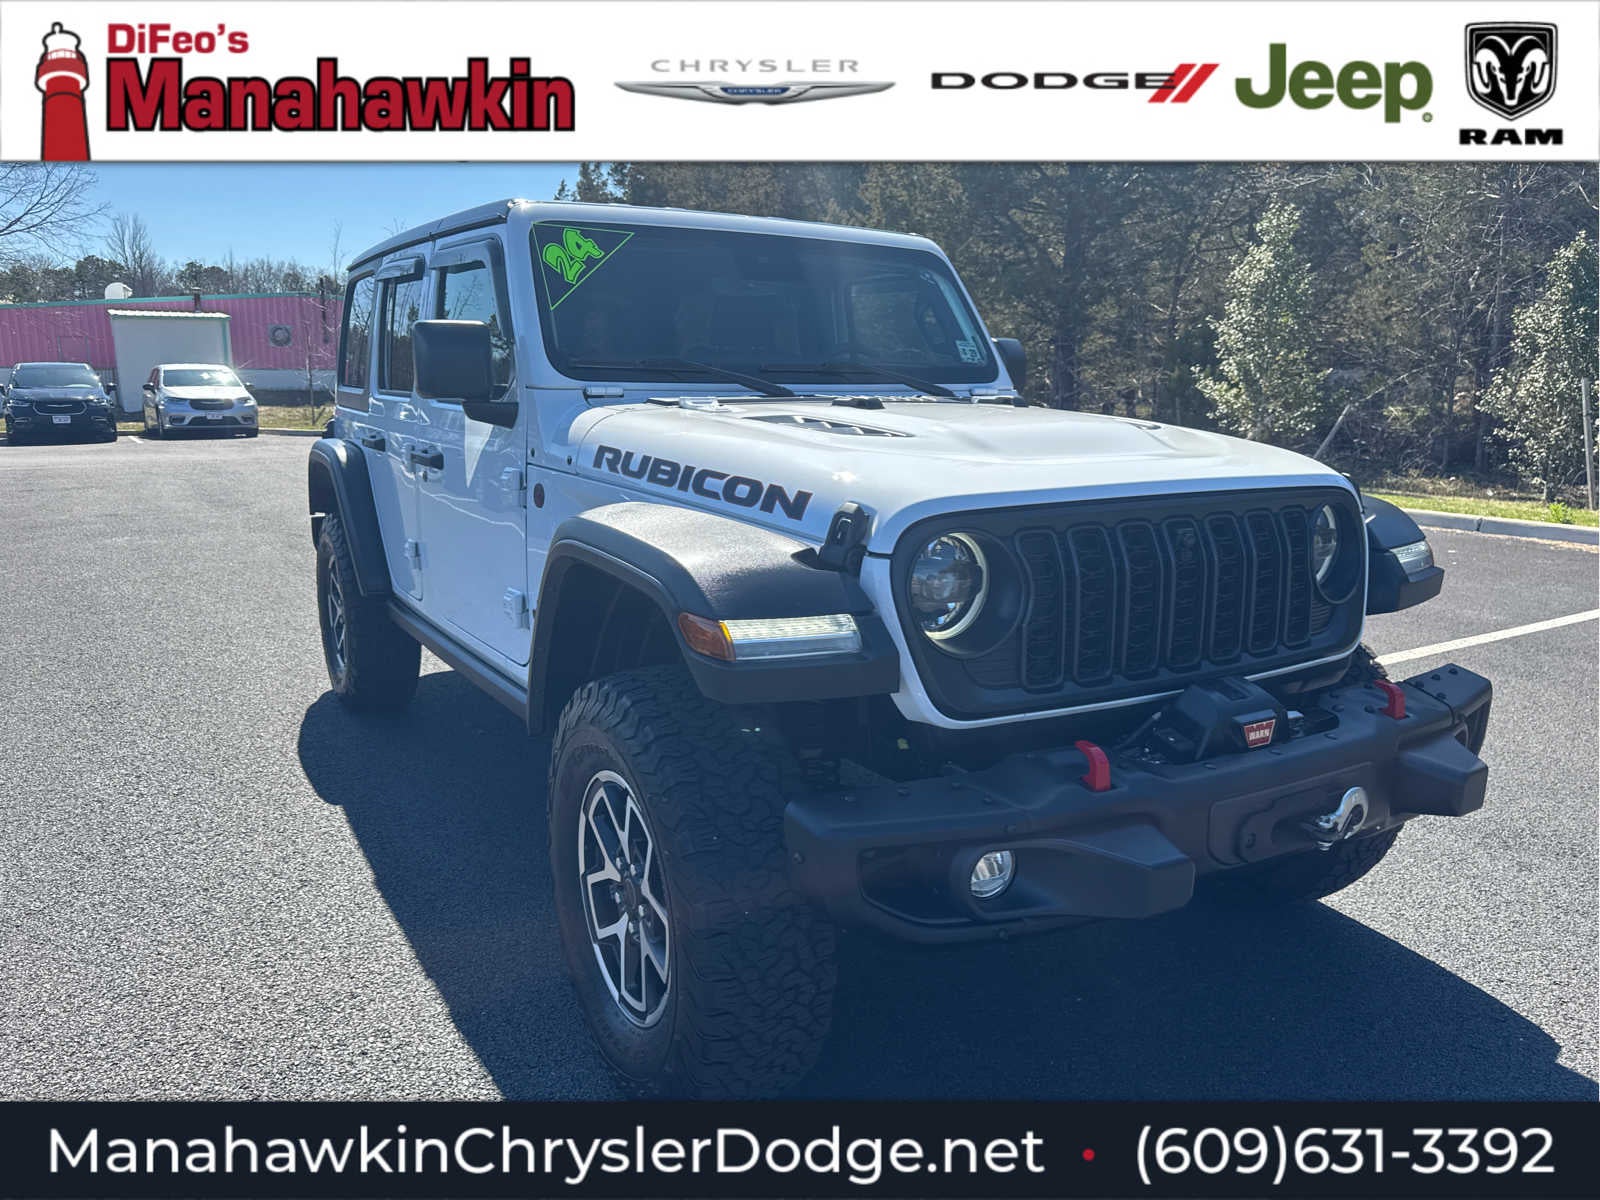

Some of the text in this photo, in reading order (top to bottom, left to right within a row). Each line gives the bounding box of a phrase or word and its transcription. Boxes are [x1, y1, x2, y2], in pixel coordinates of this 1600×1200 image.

[542, 228, 605, 284] 24
[592, 444, 814, 521] RUBICON
[1248, 728, 1271, 741] WARN
